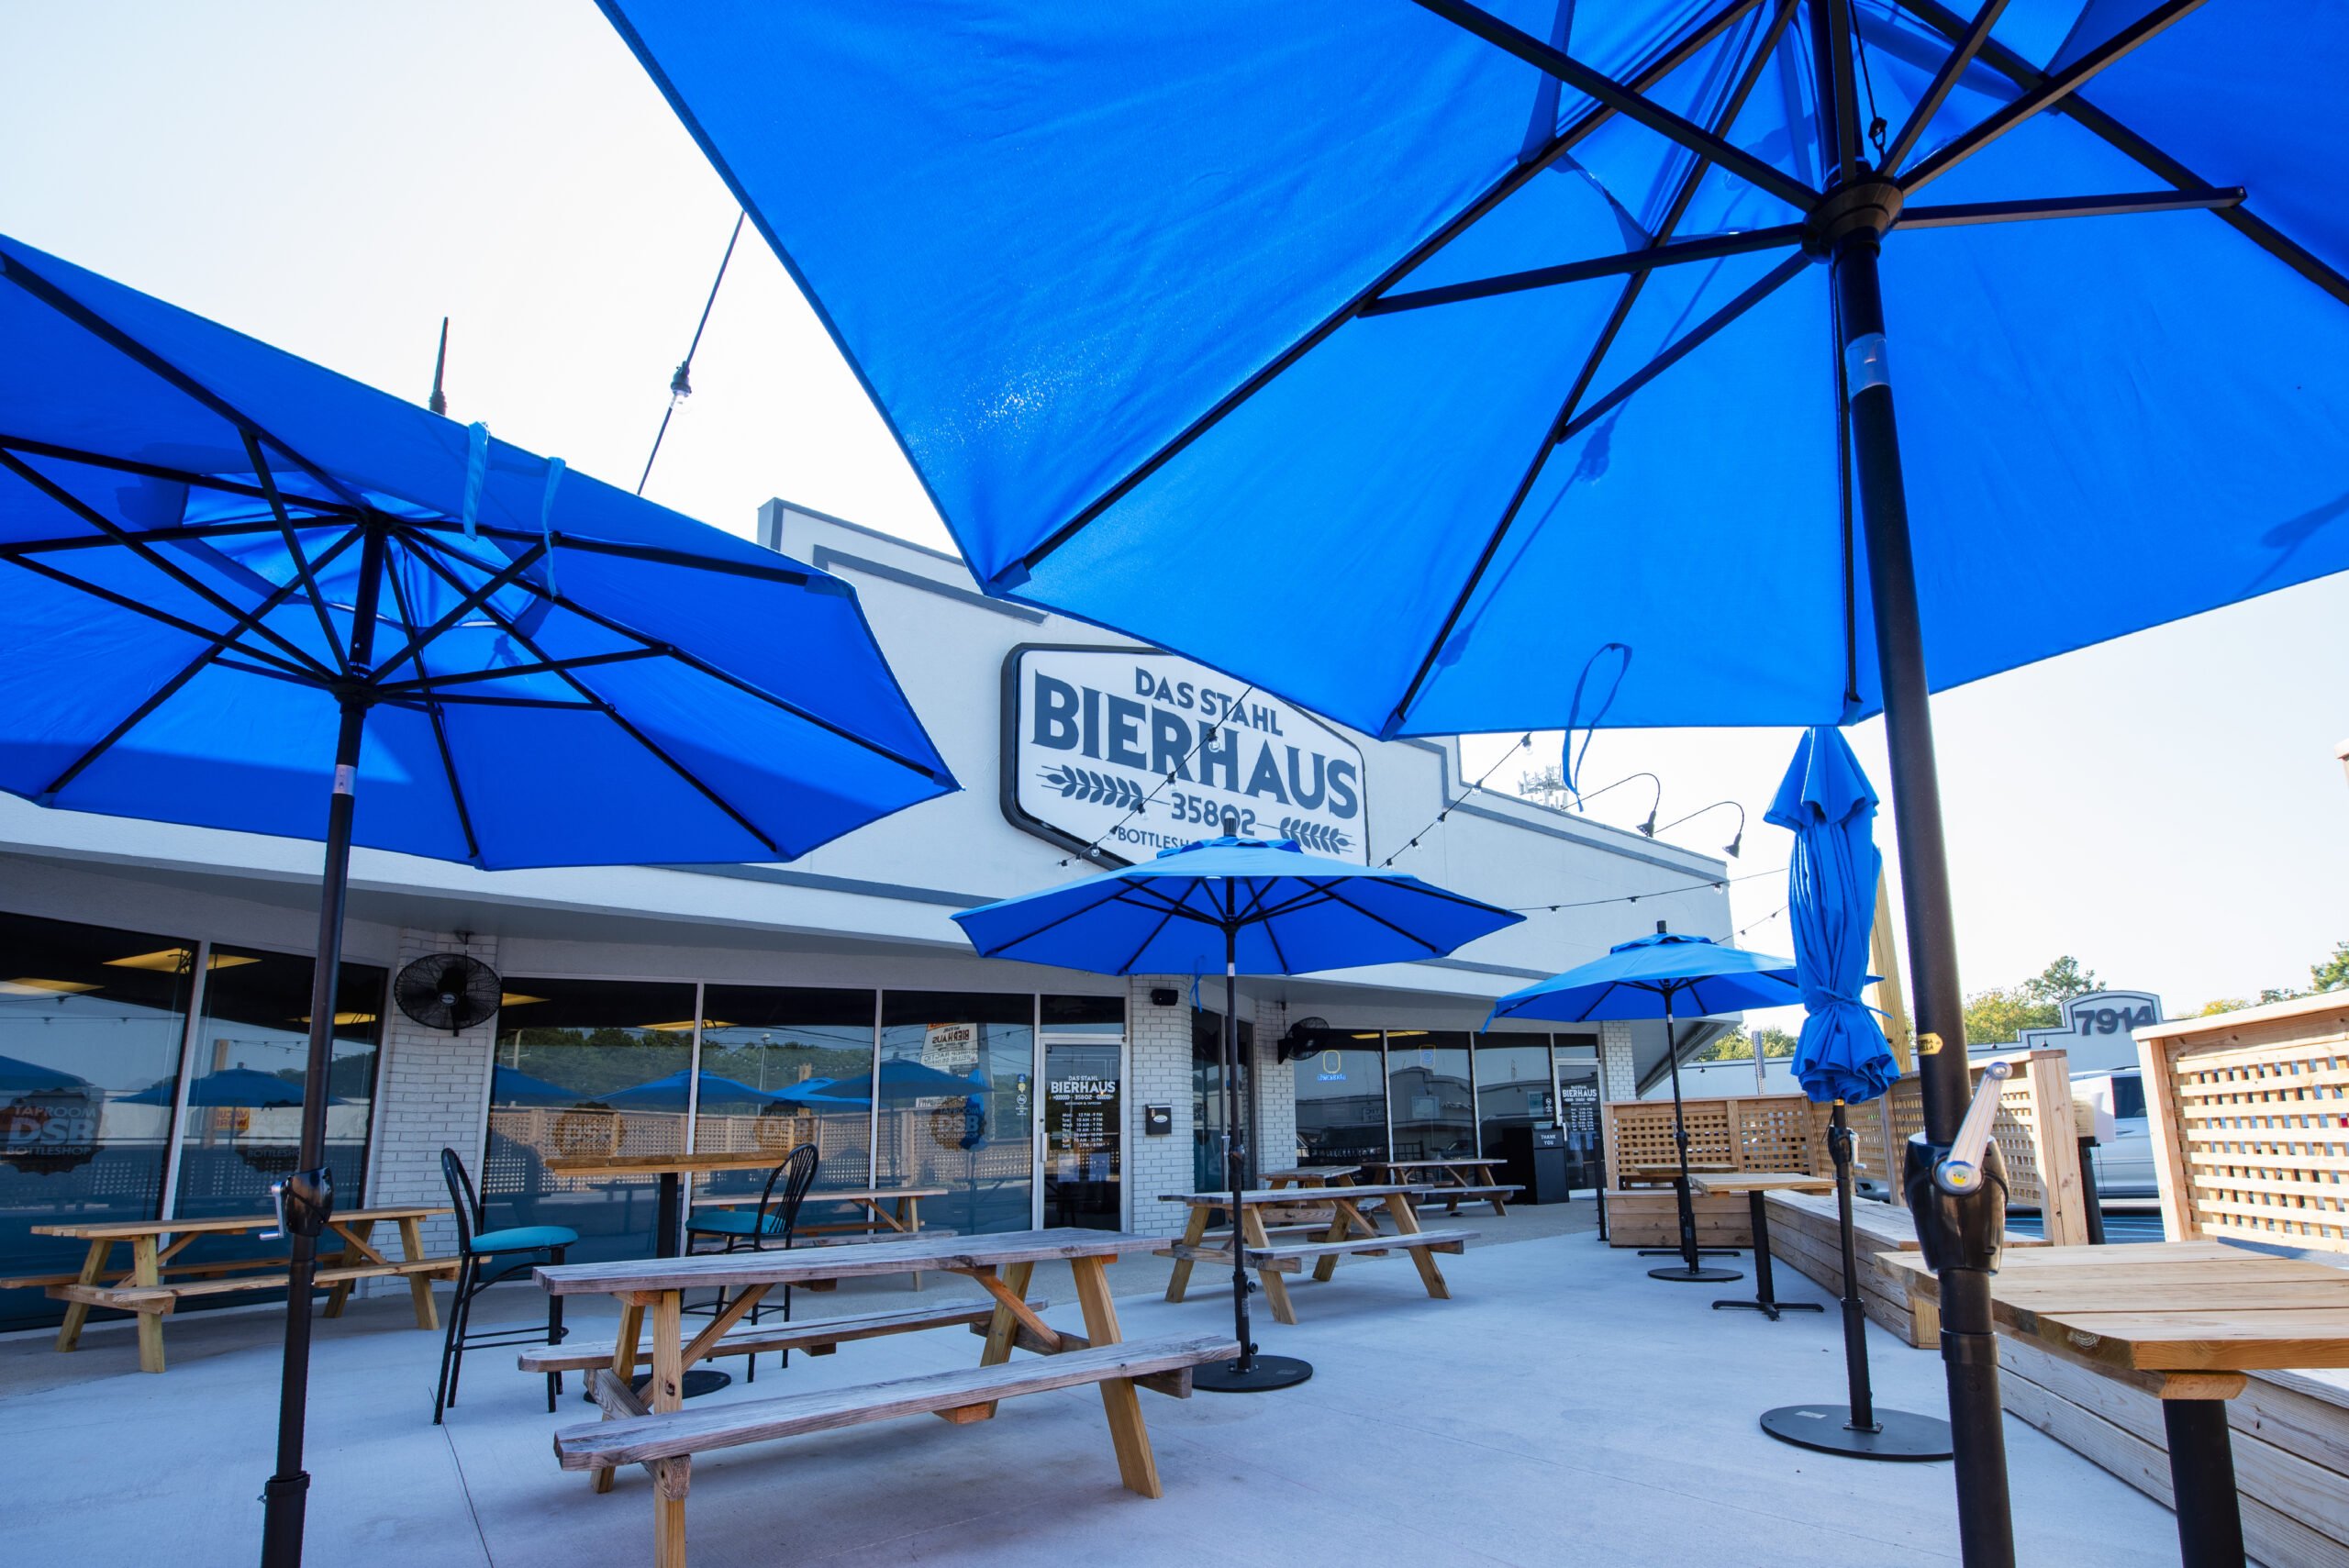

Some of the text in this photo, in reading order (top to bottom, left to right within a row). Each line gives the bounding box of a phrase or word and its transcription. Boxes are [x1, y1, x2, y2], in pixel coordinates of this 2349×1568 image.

[1135, 666, 1283, 737] DAS STAHL
[1030, 669, 1358, 819] BIERHAUS
[1171, 792, 1256, 836] 35802
[1118, 827, 1190, 849] BOTTLESH
[2075, 1006, 2154, 1036] 7914
[1051, 1081, 1116, 1094] BIERHAUS
[1562, 1089, 1598, 1098] BIERHAUS
[14, 1105, 96, 1118] TAPROOM
[250, 1115, 301, 1125] TAPROO
[7, 1118, 95, 1146] DSB
[6, 1146, 92, 1155] BOTTLESHOP
[247, 1149, 300, 1157] BOTTLESHO
